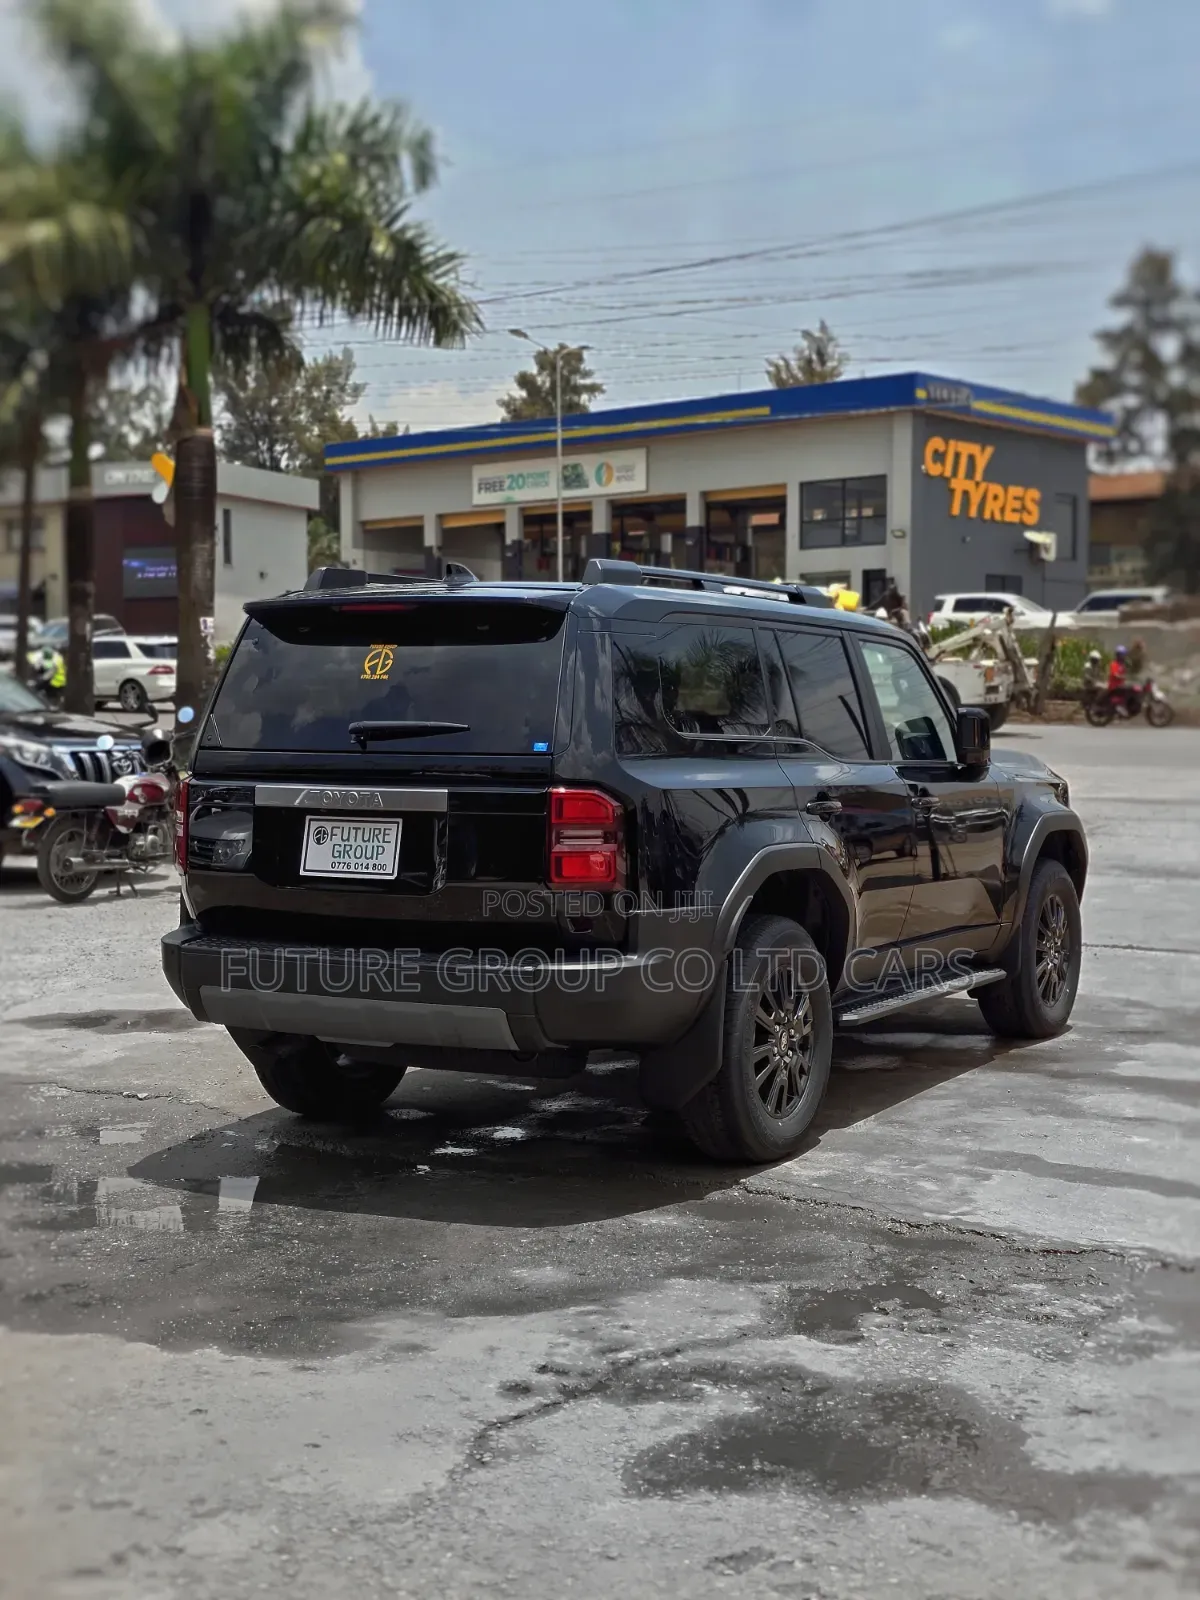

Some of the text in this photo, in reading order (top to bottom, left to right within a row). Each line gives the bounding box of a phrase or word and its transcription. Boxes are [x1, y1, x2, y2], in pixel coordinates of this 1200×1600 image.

[924, 435, 995, 482] CITY
[478, 473, 526, 494] FREE 20
[950, 478, 1041, 526] TYRES
[309, 790, 384, 808] TOYOTA
[329, 826, 392, 843] FUTURE
[332, 844, 385, 860] GROUP
[331, 861, 351, 870] 0776
[372, 863, 387, 871] 800
